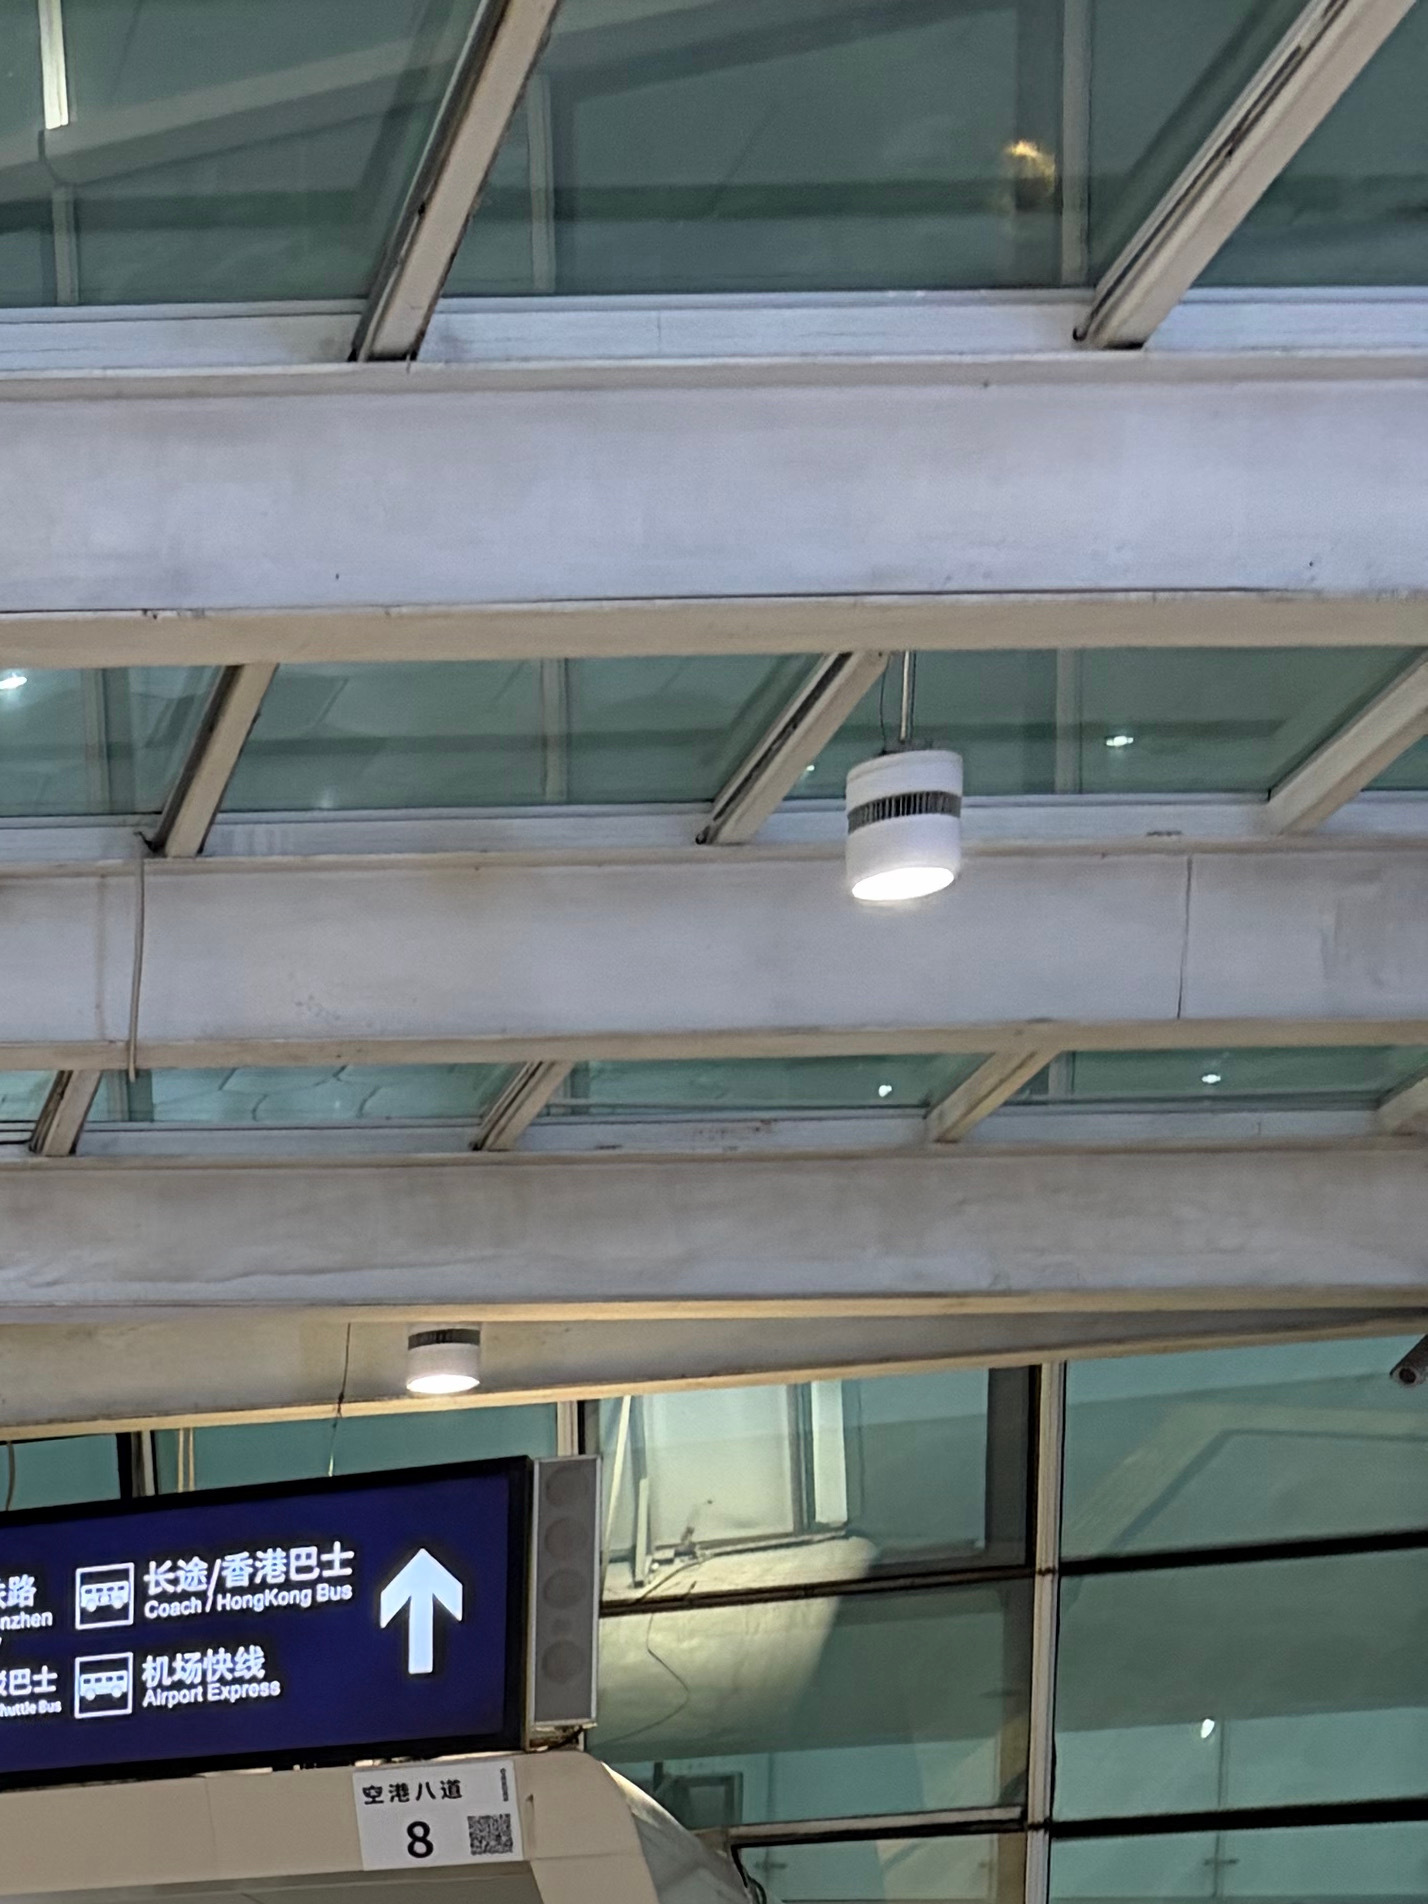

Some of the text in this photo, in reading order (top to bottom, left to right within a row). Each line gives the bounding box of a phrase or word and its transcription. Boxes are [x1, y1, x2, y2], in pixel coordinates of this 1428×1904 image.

[144, 1541, 355, 1597] 长途/香港巴士
[144, 1597, 202, 1619] Coach
[216, 1587, 314, 1612] HongKong
[316, 1583, 353, 1602] Bus
[142, 1645, 265, 1688] 机场快线
[38, 1699, 62, 1714] Bus
[143, 1680, 281, 1708] Airport Express
[362, 1779, 463, 1805] 空港八道
[407, 1821, 434, 1858] 8
